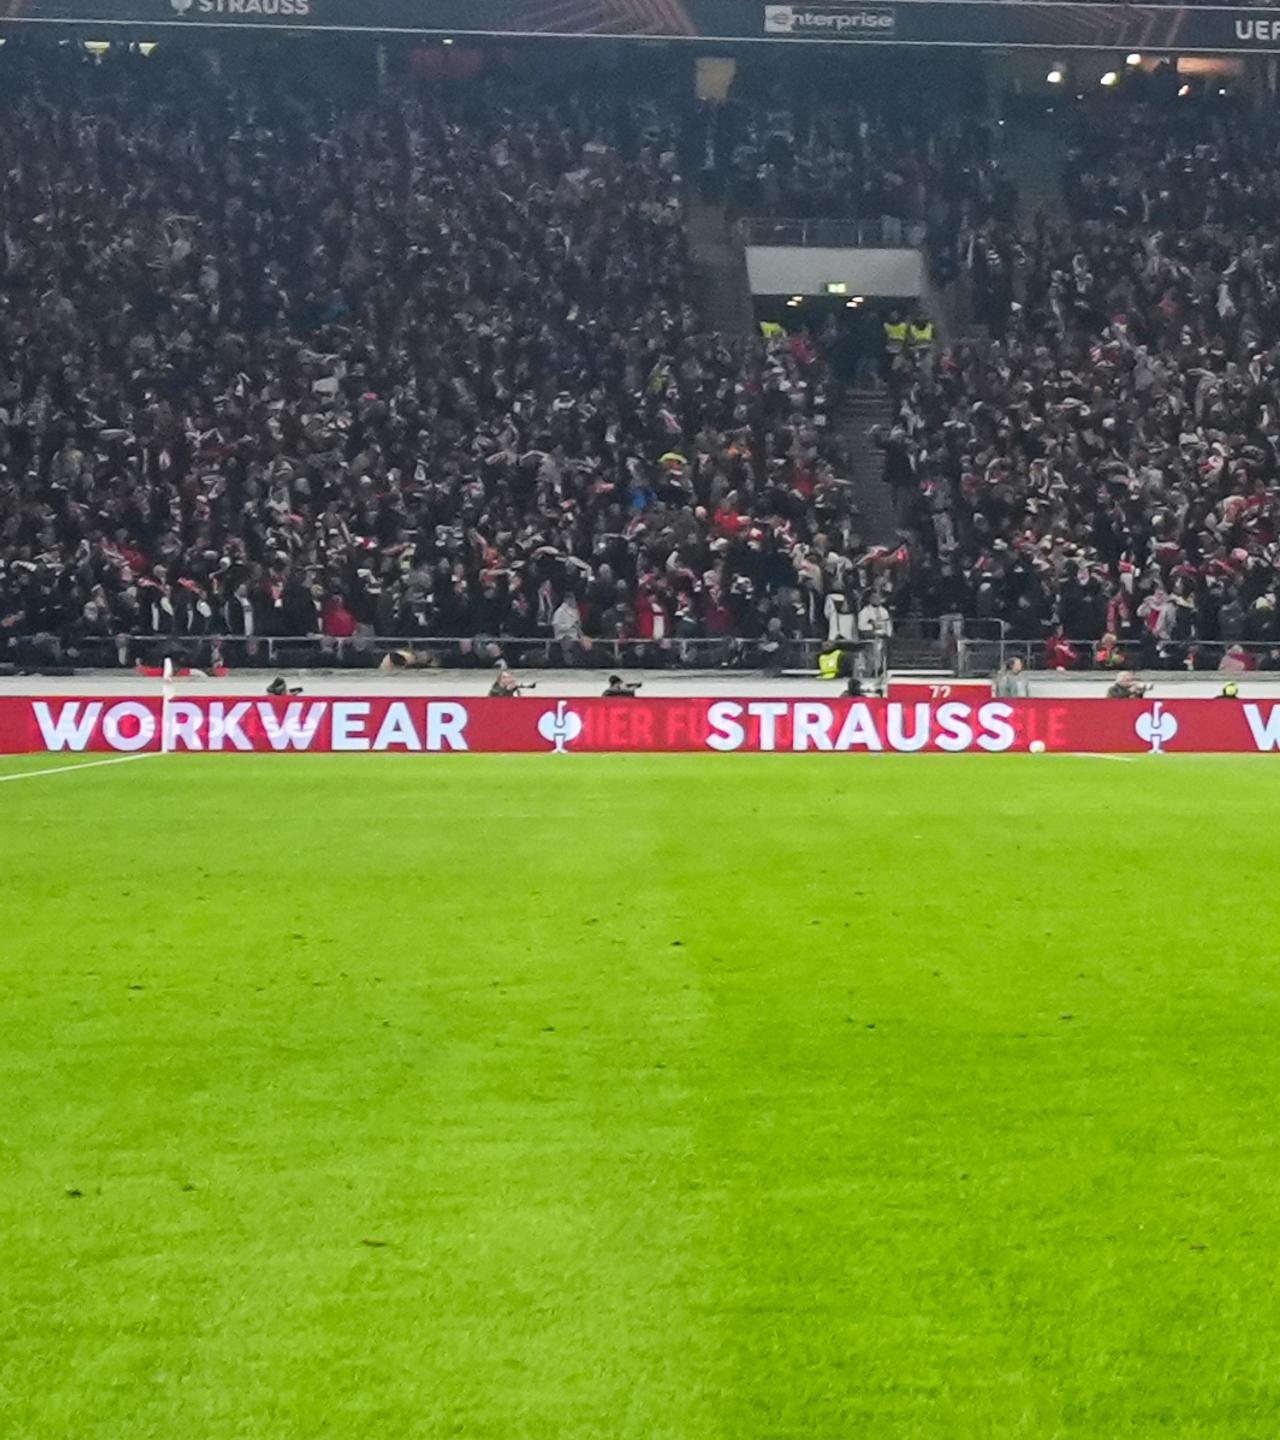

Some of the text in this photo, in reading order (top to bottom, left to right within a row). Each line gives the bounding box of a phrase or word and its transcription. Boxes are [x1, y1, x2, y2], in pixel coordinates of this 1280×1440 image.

[766, 8, 895, 32] enterprise
[31, 700, 469, 752] WORKWEAR
[705, 701, 1016, 753] STRAUSS
